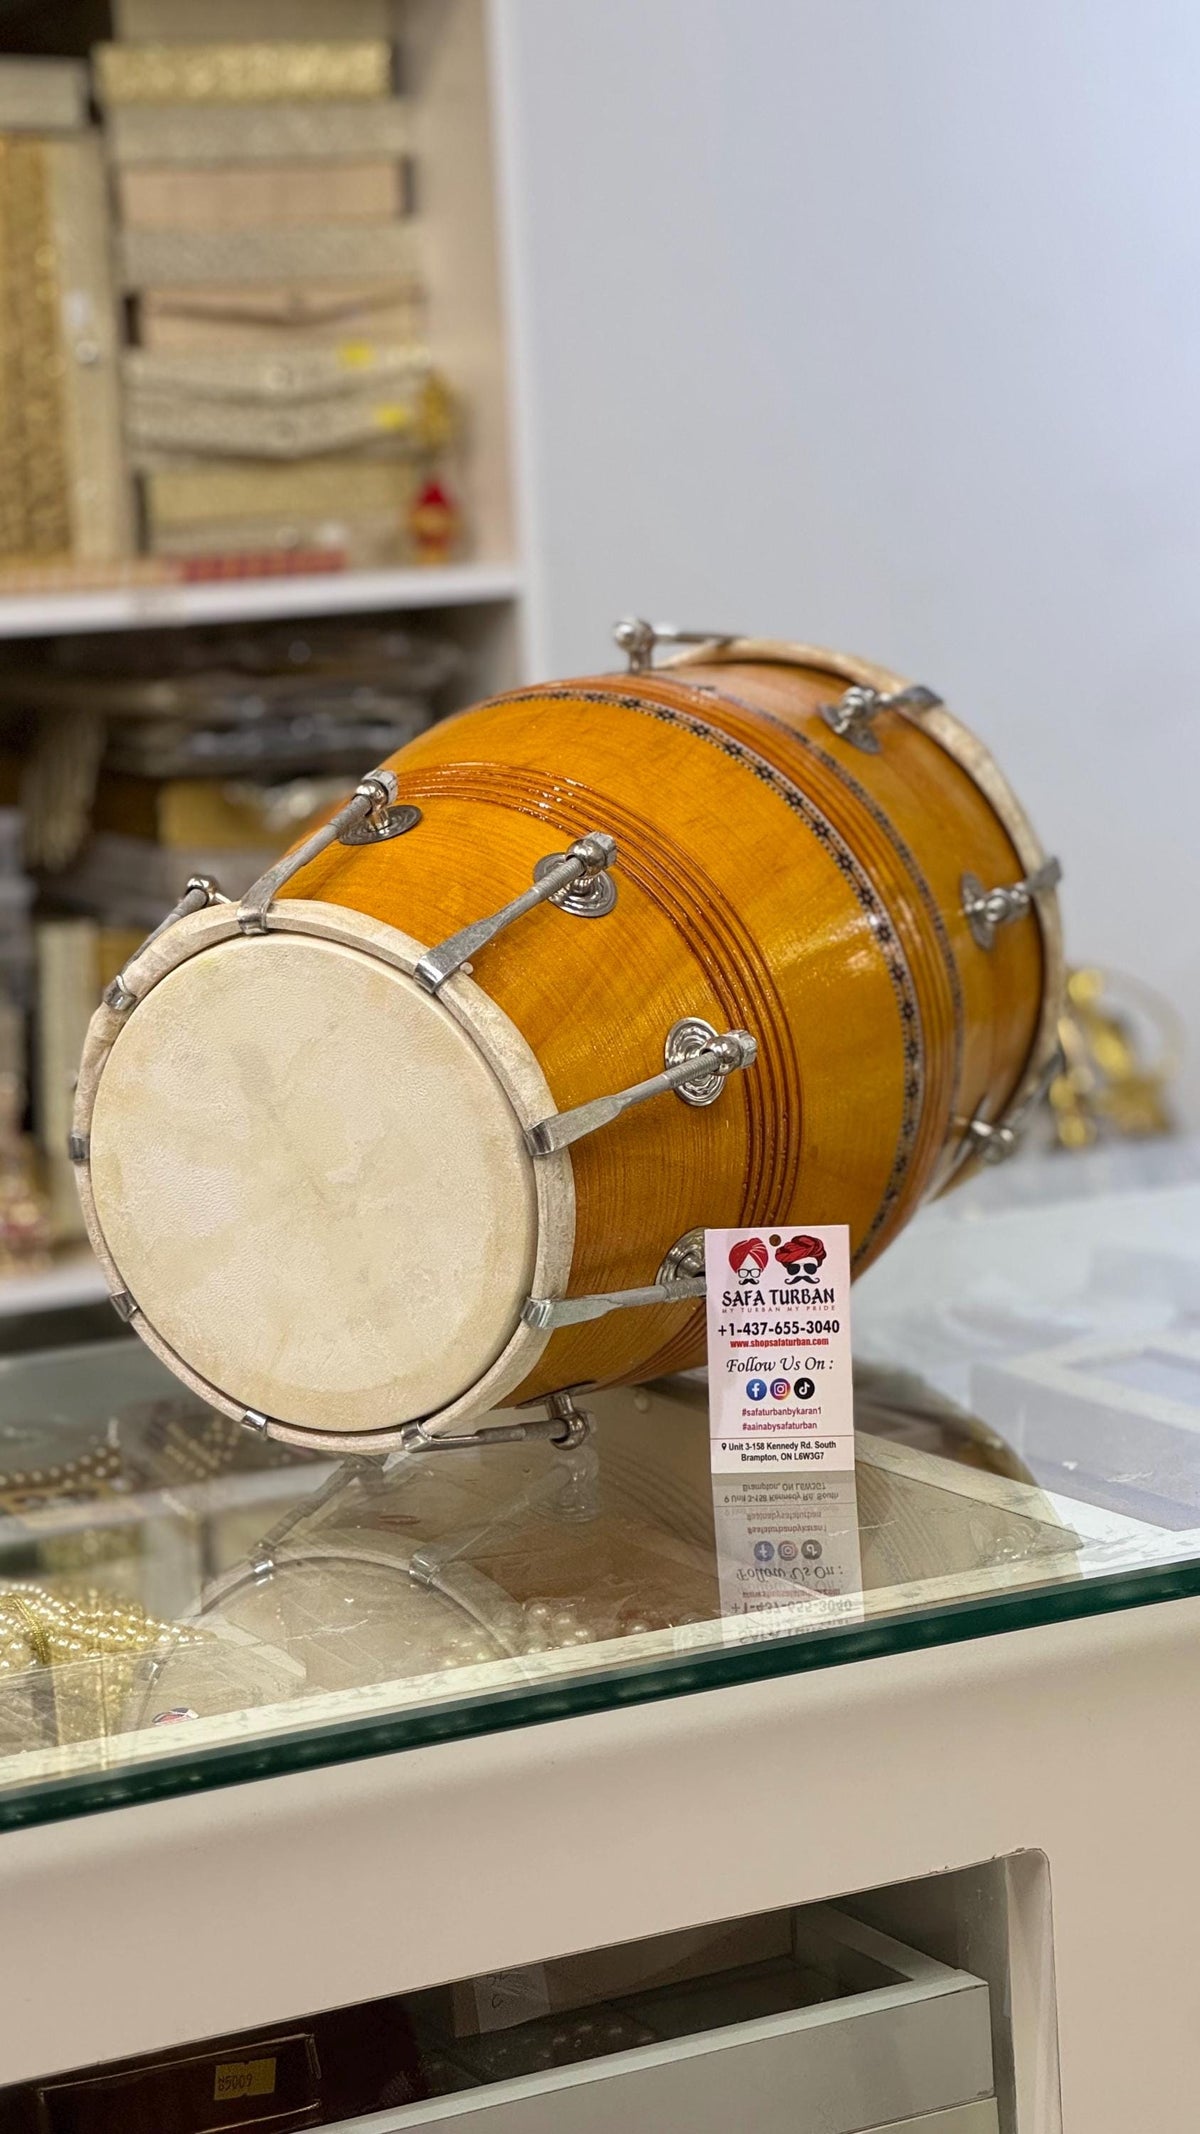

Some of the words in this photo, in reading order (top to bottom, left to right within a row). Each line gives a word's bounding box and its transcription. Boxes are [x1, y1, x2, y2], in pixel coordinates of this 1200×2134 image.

[722, 1290, 766, 1307] SAFA
[769, 1288, 835, 1305] TURBAN
[718, 1320, 840, 1336] +1-437-655-3040
[730, 1338, 830, 1348] www.shopsafaturban.com
[726, 1356, 776, 1372] Follow
[780, 1355, 801, 1371] Us
[804, 1356, 826, 1371] On
[742, 1407, 822, 1417] #safaturbanbykaran1
[742, 1422, 818, 1432] #aainabysafaturban
[728, 1442, 744, 1451] Unit
[745, 1442, 765, 1450] 3-158
[766, 1442, 798, 1451] Kennedy
[800, 1441, 813, 1449] Rd.
[814, 1441, 837, 1449] South
[741, 1453, 779, 1463] Brampton,
[780, 1452, 792, 1461] ON
[794, 1452, 824, 1461] L6W3G7
